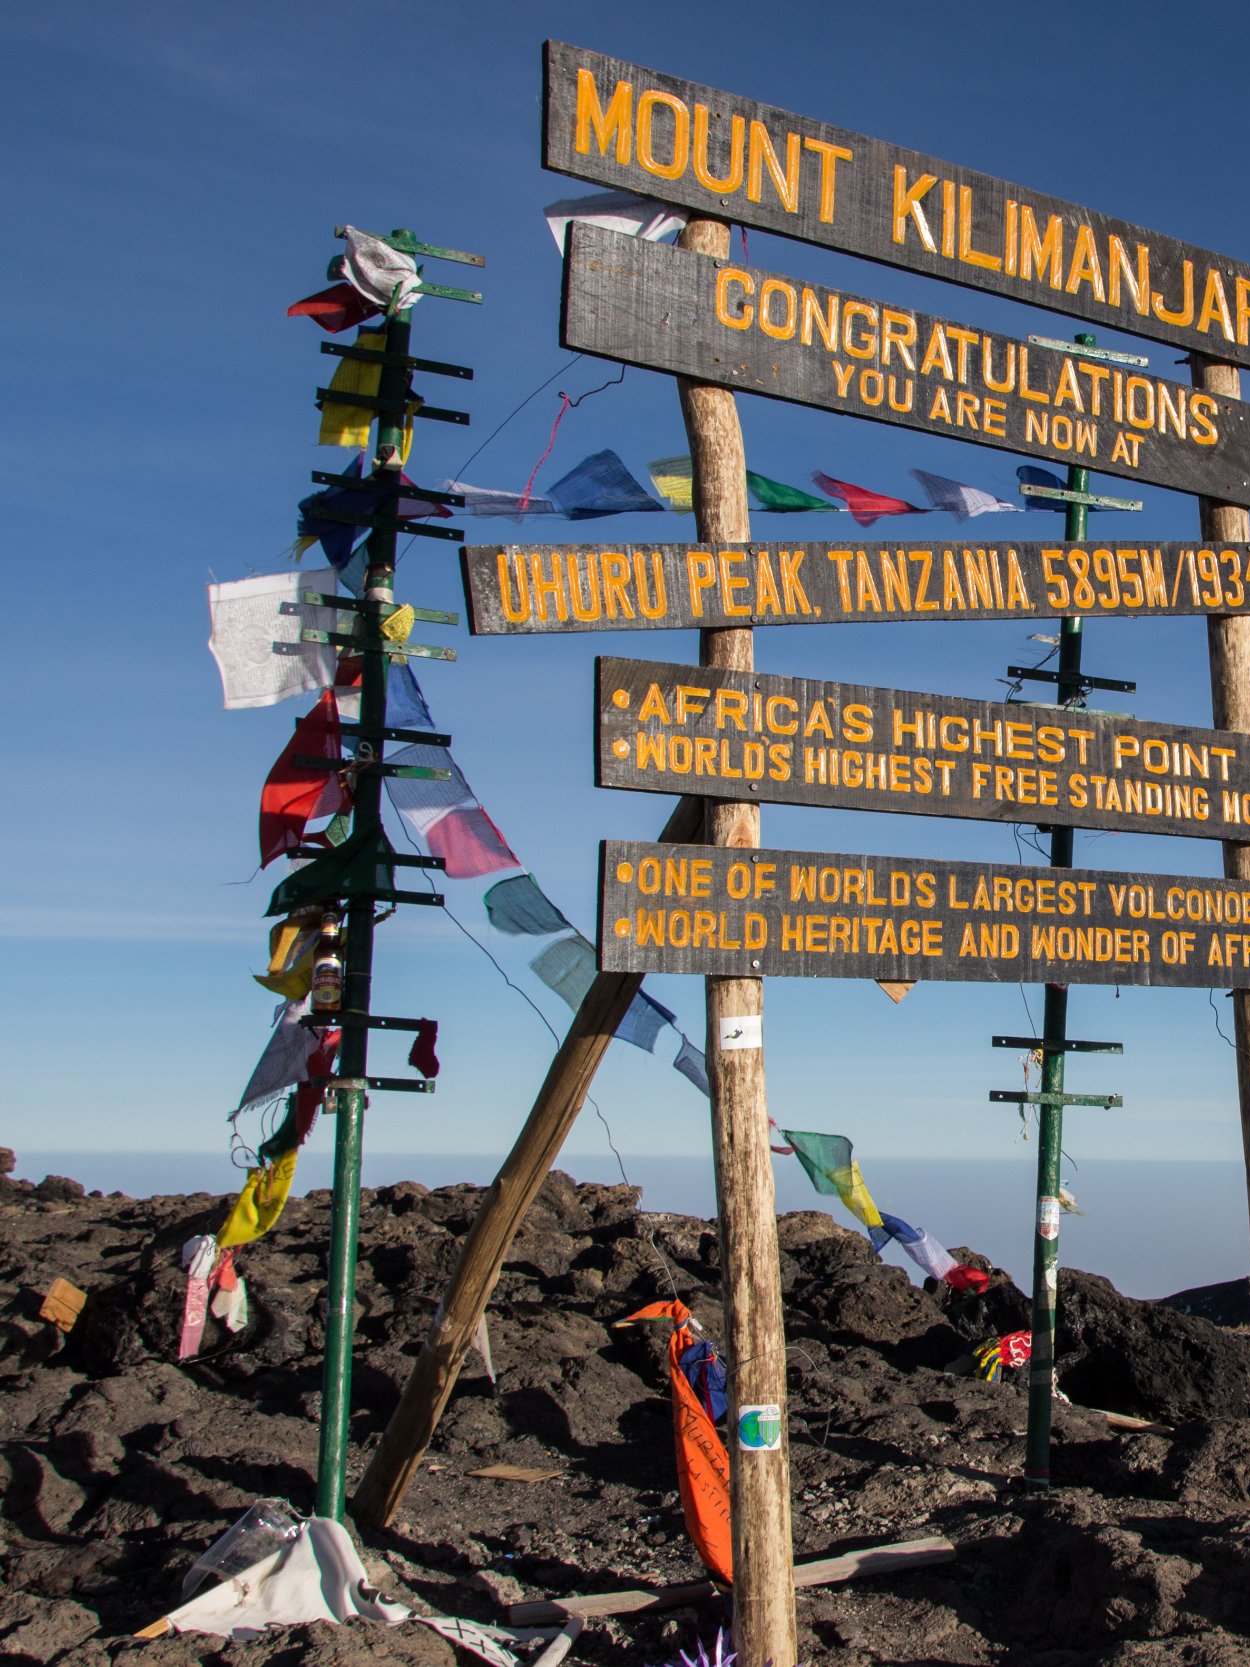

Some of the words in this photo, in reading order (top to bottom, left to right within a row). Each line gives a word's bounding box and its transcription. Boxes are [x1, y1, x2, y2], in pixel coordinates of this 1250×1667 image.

[575, 69, 853, 223] MOUNT
[716, 267, 1217, 444] CONGRATULATIONS
[832, 360, 912, 412] YOU
[930, 387, 1005, 436] ARE
[1026, 409, 1095, 455] NOW
[1111, 432, 1145, 466] AT
[497, 552, 667, 623] UHURU
[636, 731, 791, 781] WORLD'S
[804, 746, 956, 794] HIGHEST
[972, 763, 1058, 805] FREE
[1069, 773, 1208, 820] STANDING
[639, 683, 871, 742] AFRICA'S
[893, 709, 1095, 764] HIGHEST
[1114, 736, 1236, 779] POINT
[637, 857, 712, 897] ONE
[727, 862, 776, 899] OF
[790, 865, 936, 908] WORLD'S
[949, 875, 1096, 915] LARGEST
[636, 907, 767, 950] WORLD
[782, 914, 943, 956] HERITAGE
[960, 923, 1018, 958] AND
[1032, 925, 1150, 962] WONDER
[1162, 931, 1195, 964] OF
